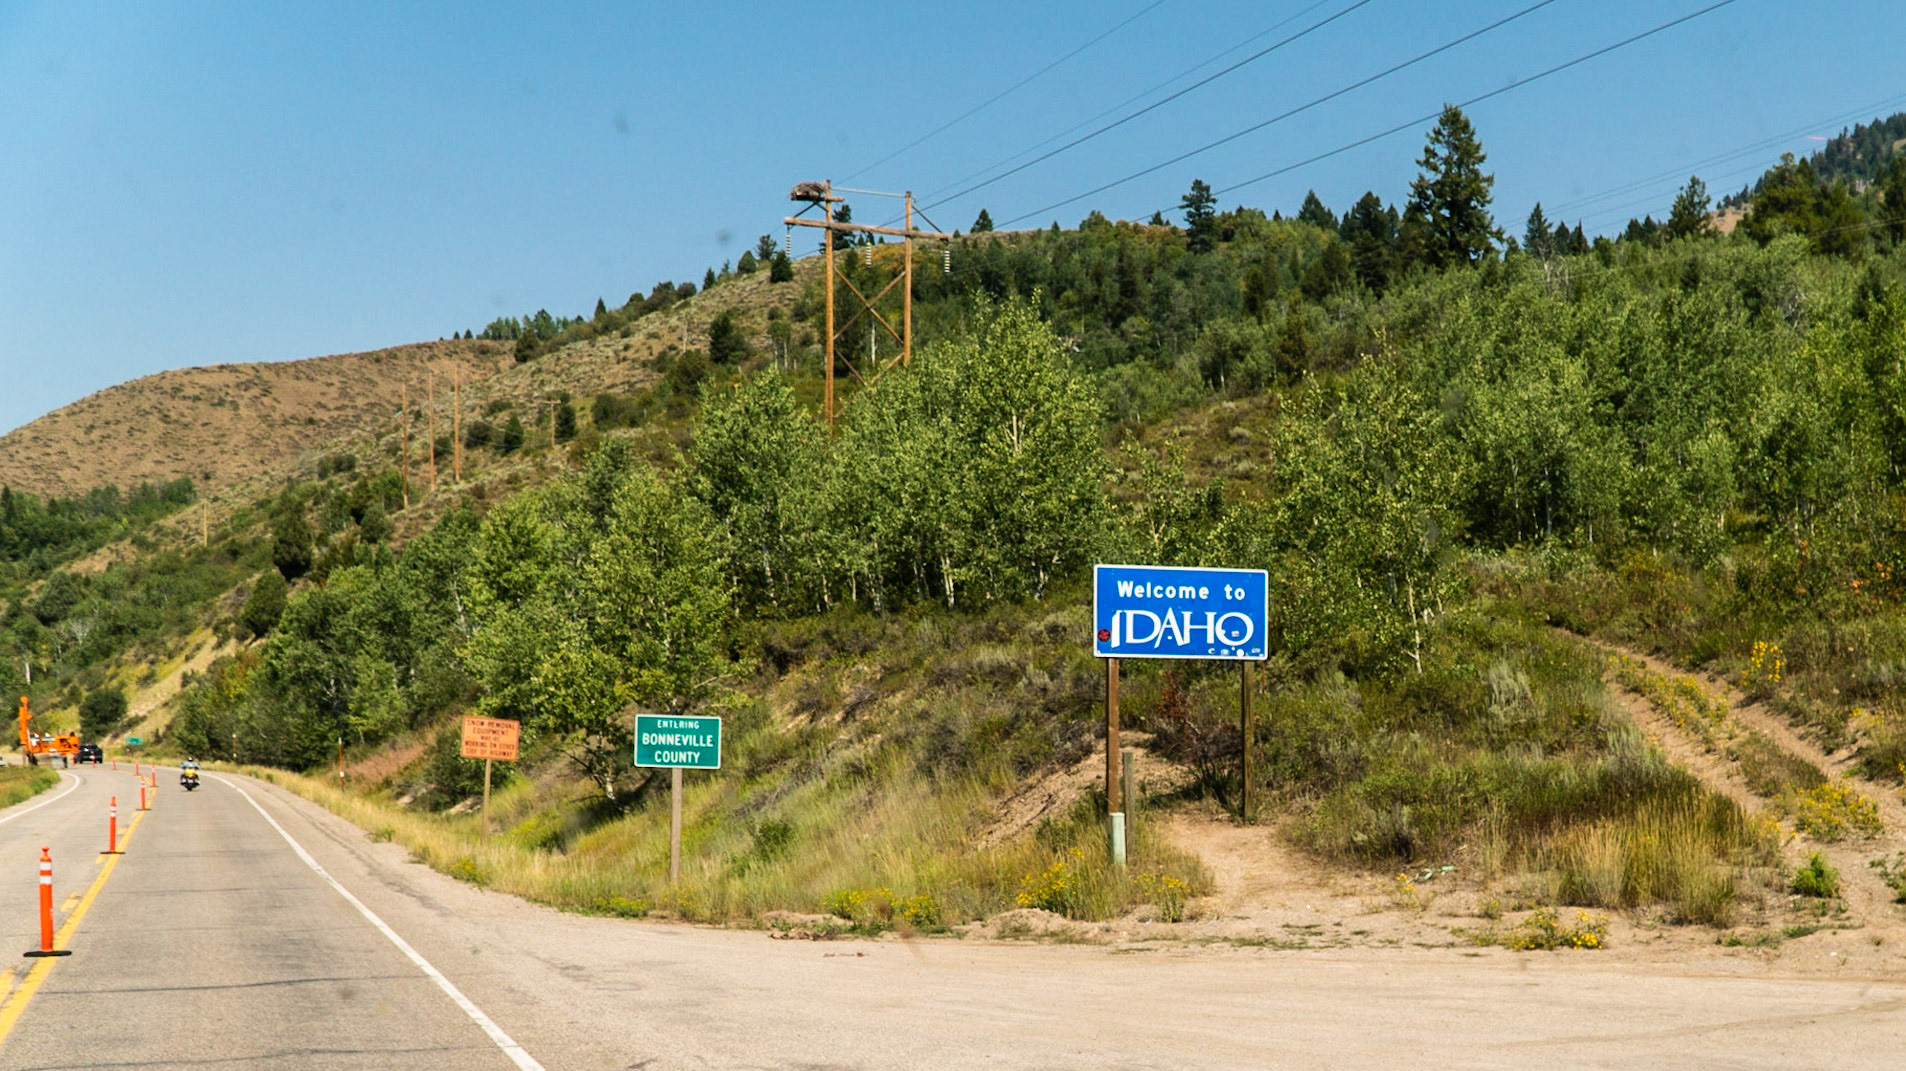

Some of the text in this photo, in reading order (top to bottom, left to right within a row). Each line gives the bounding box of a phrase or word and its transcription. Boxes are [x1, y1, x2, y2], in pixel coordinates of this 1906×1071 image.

[1117, 581, 1246, 600] Welcome to
[1111, 607, 1254, 648] IDAHO
[657, 719, 700, 729] ENTERING
[642, 732, 714, 747] BONNEVILLE
[654, 750, 700, 764] COUNTY
